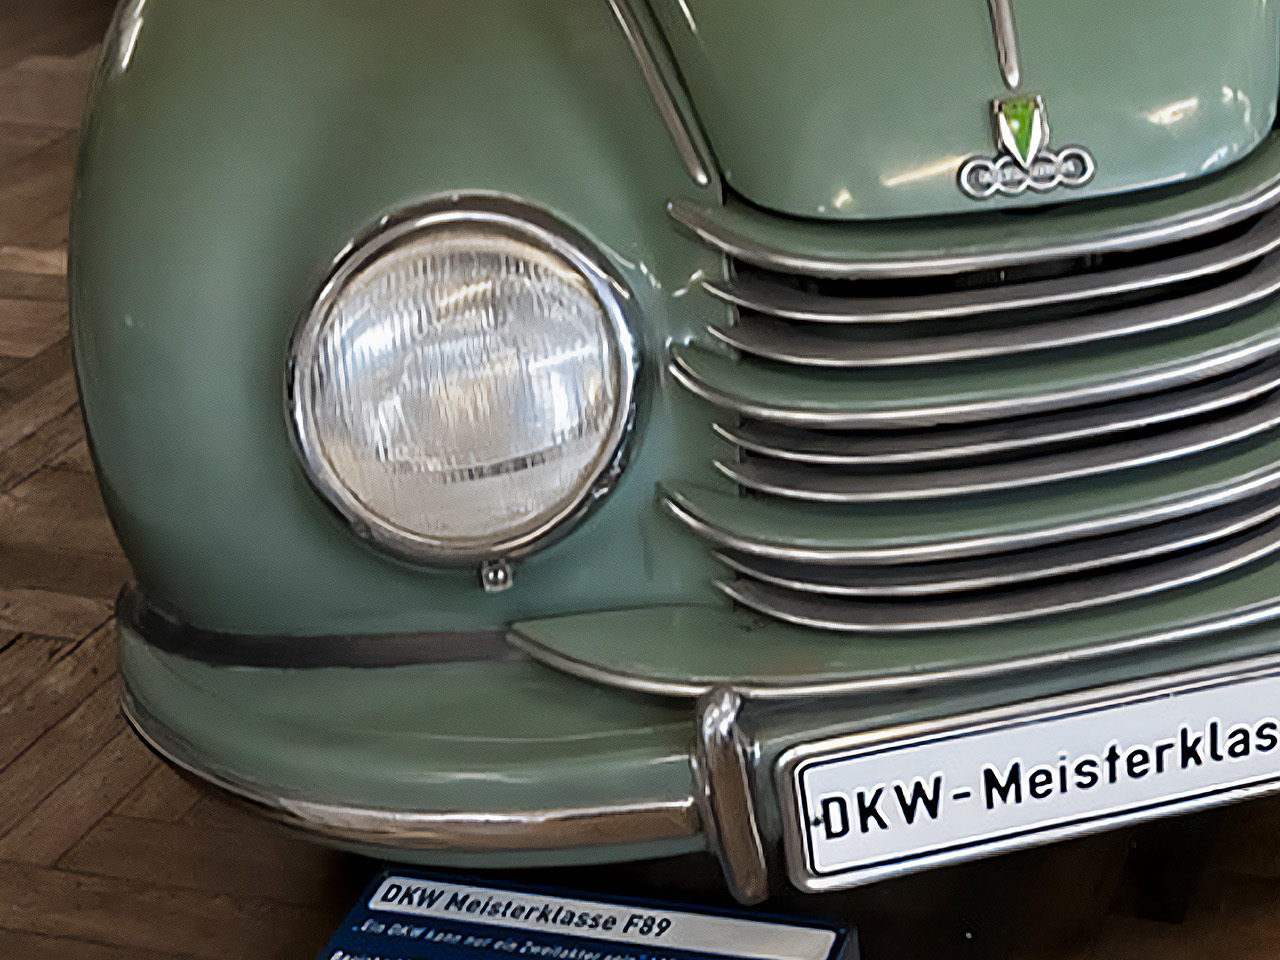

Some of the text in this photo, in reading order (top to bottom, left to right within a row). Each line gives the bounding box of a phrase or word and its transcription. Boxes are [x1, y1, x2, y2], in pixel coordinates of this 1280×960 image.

[380, 883, 672, 937] DKW Meisterklasse F89
